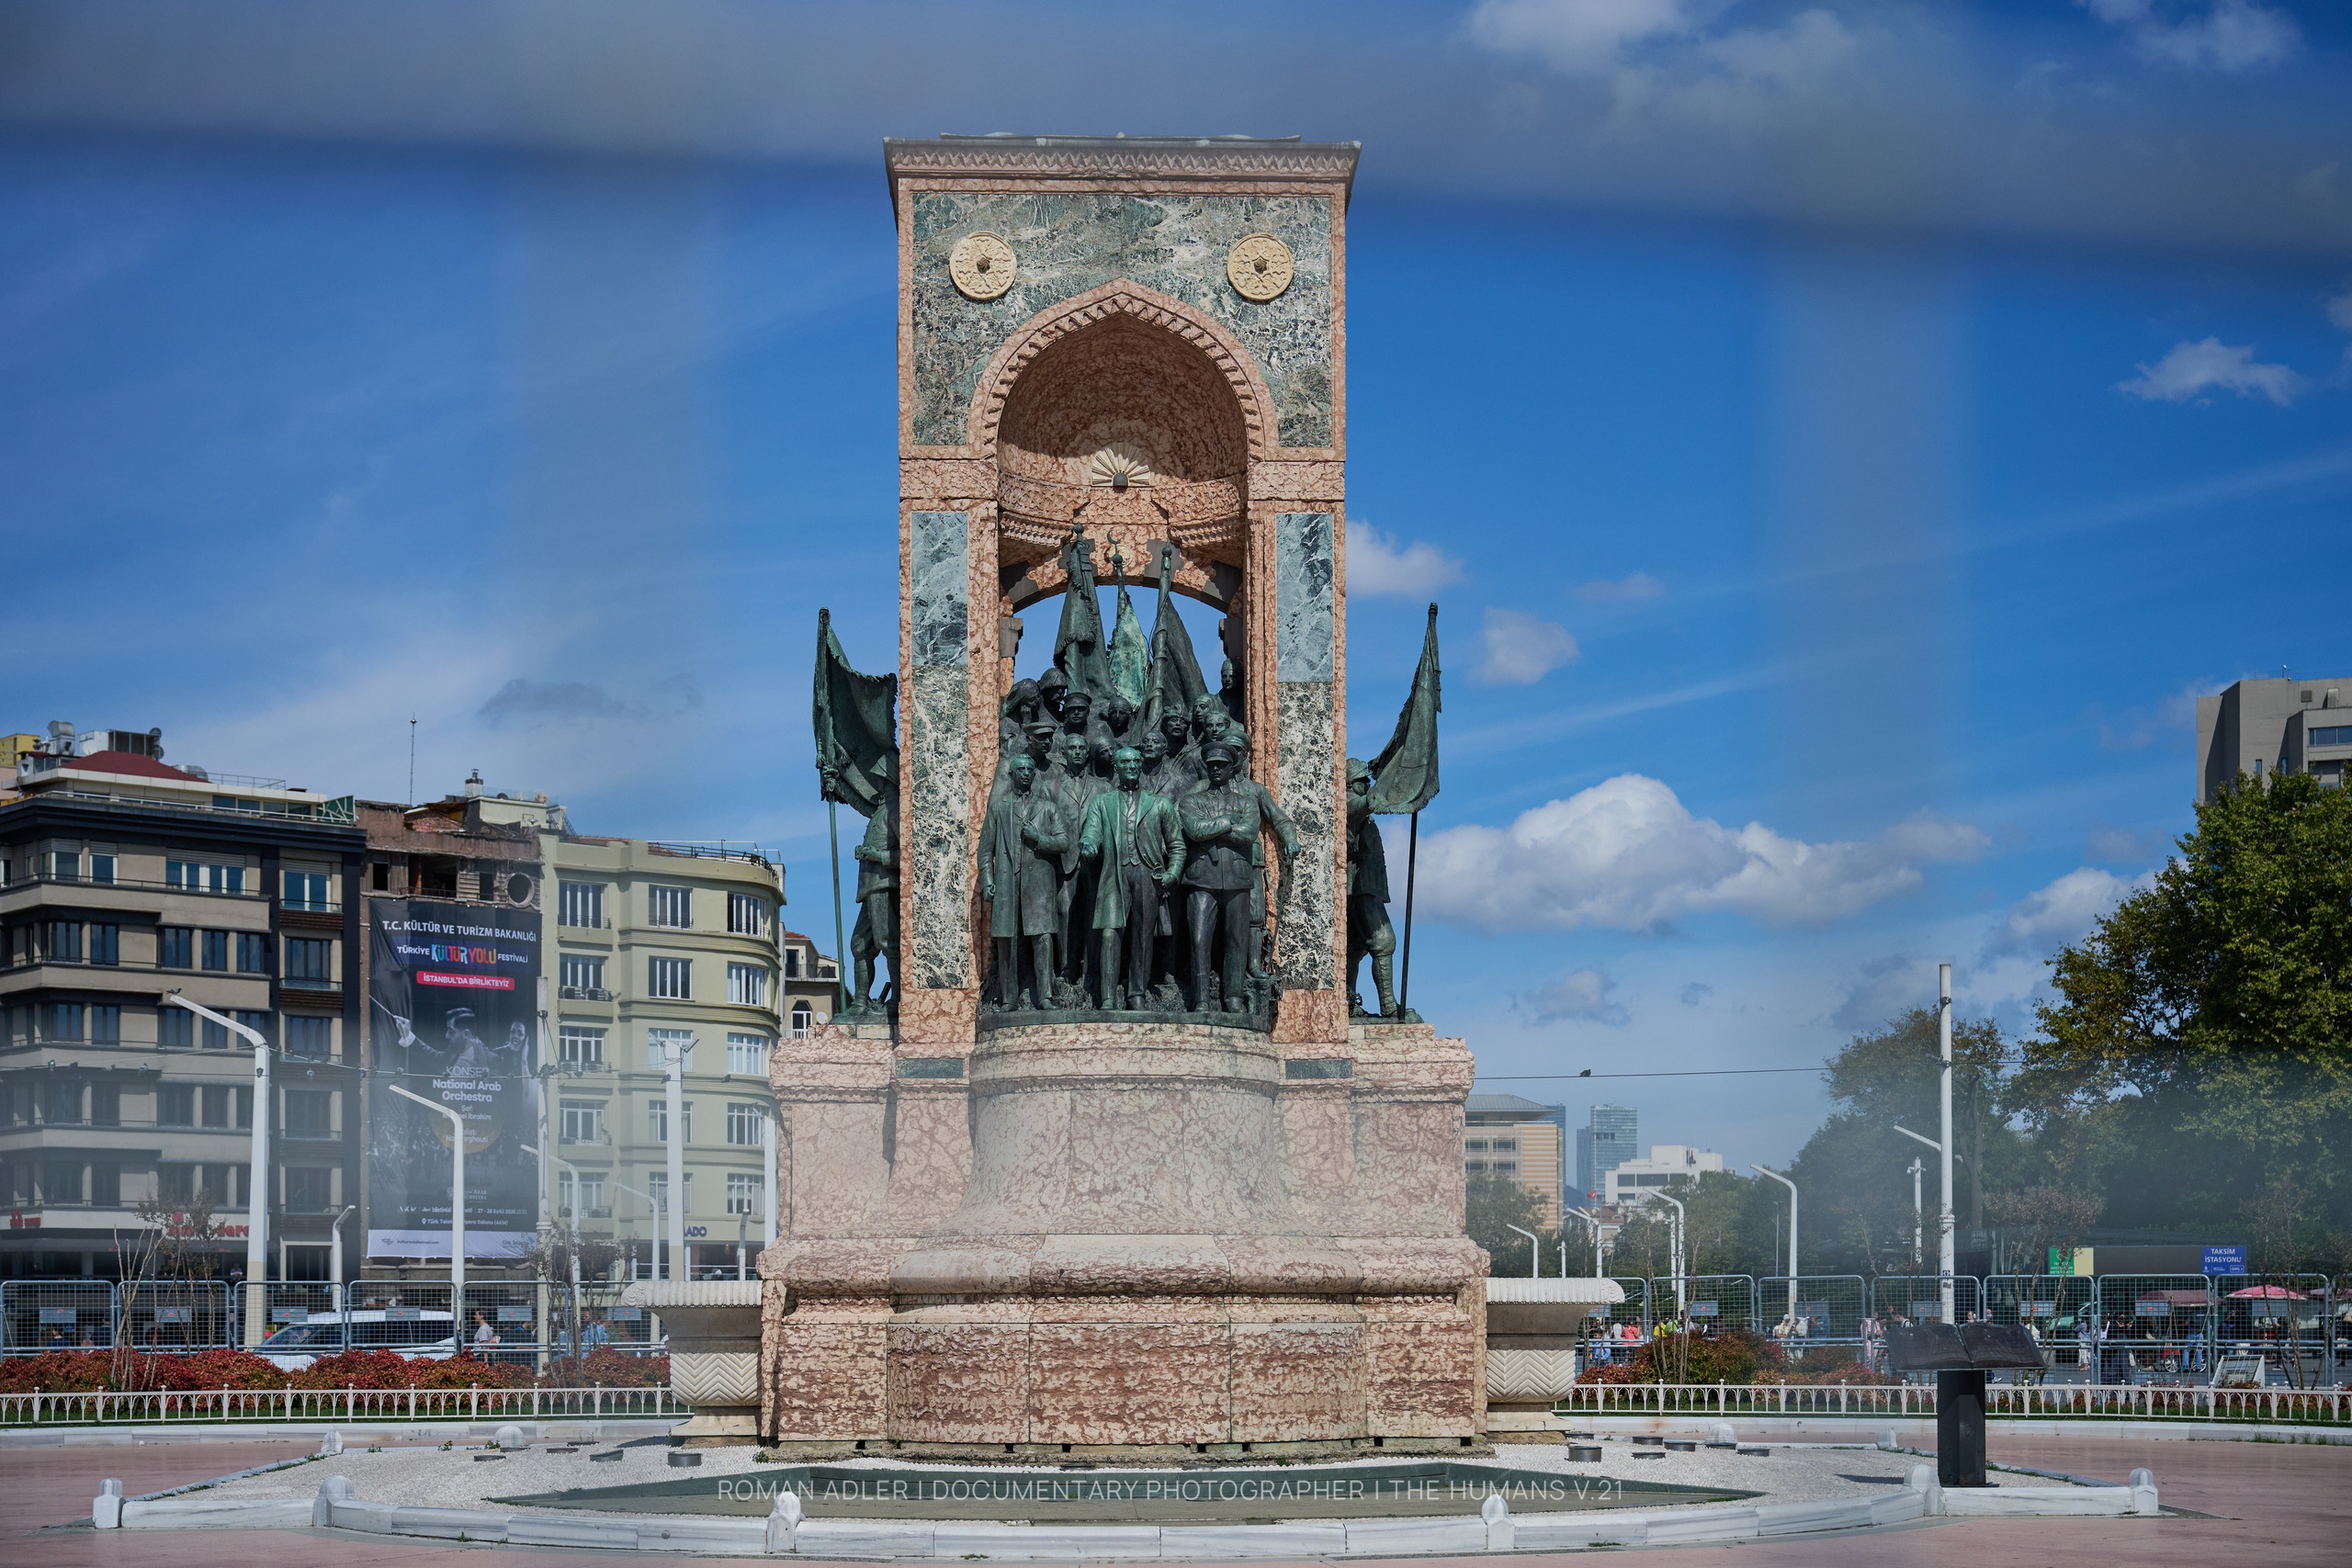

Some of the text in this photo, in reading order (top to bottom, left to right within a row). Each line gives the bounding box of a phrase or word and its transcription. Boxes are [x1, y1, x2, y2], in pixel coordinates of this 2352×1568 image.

[382, 919, 537, 942] T.C. KÜLTÜR VE TURİZM BAKANLIĞI
[397, 944, 430, 955] TÜRKİYE
[497, 953, 528, 963] FESTİVALİ
[424, 973, 509, 987] İSTANBUL'DA BİRLİKTEYİZ
[433, 1078, 502, 1091] National Arab
[442, 1090, 492, 1102] Orchestra
[684, 1224, 707, 1237] ADO
